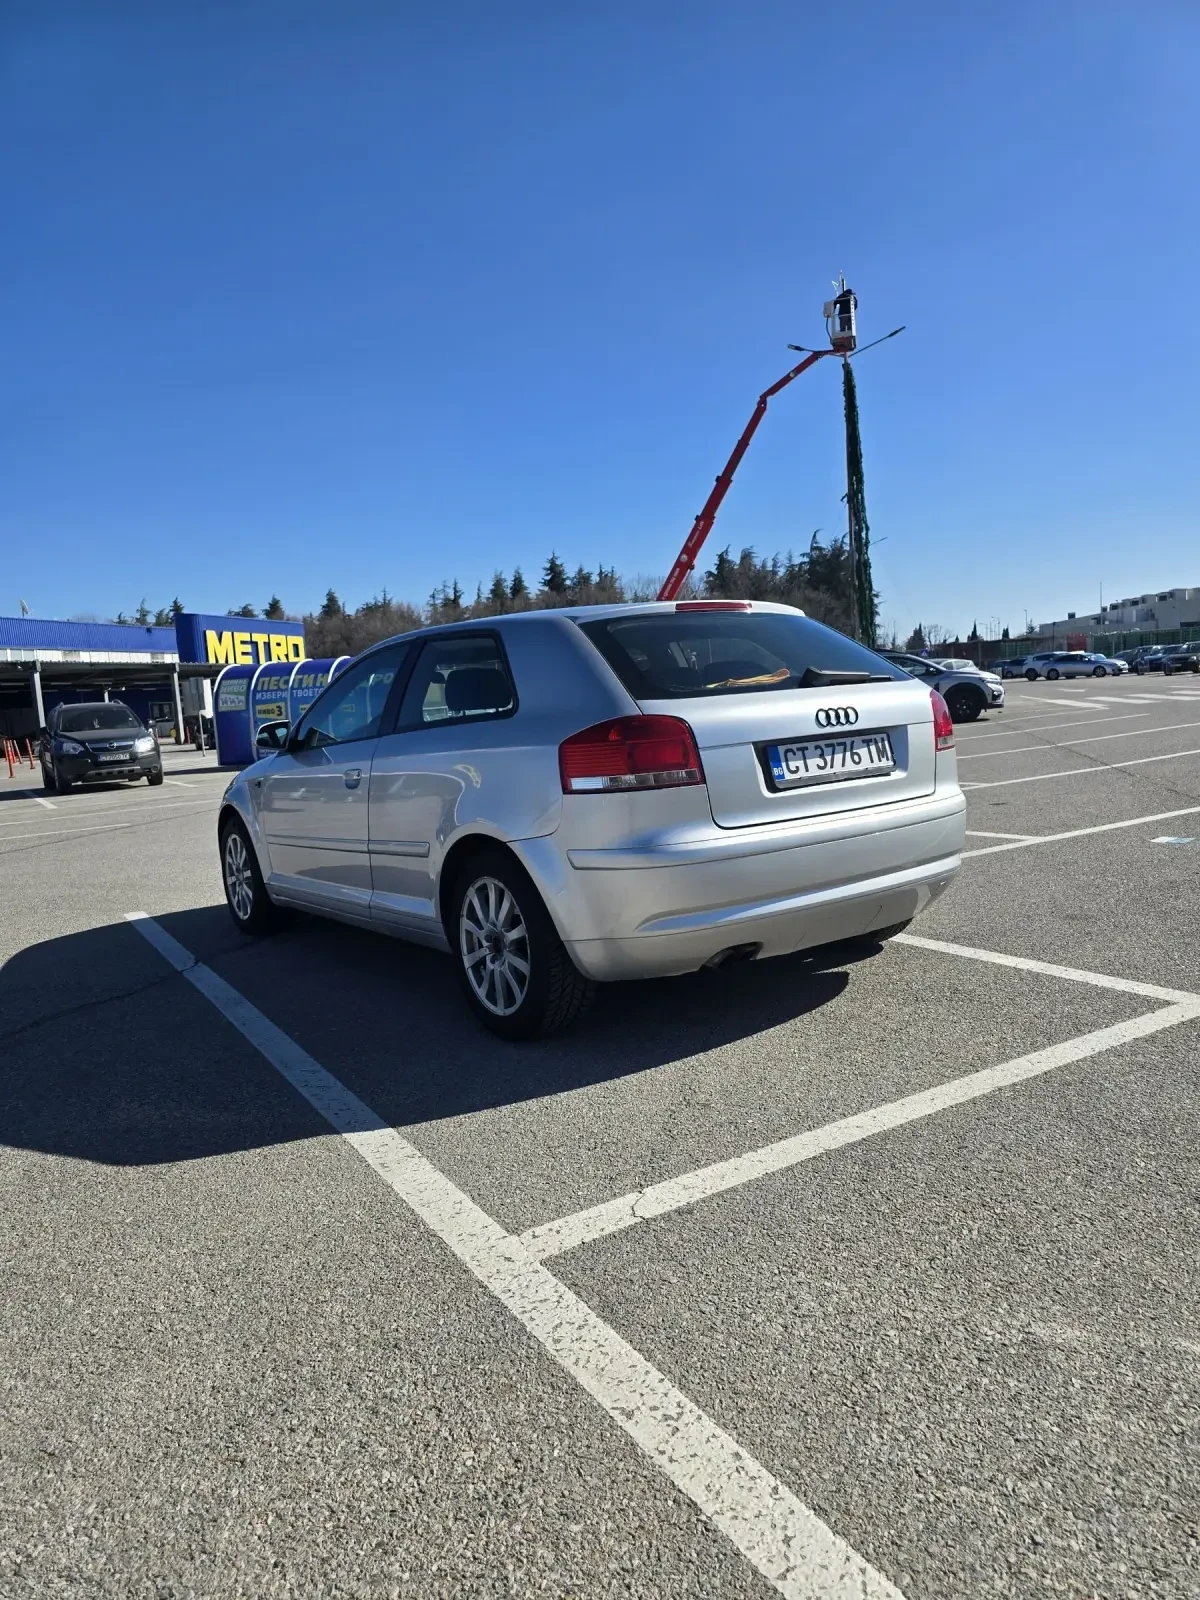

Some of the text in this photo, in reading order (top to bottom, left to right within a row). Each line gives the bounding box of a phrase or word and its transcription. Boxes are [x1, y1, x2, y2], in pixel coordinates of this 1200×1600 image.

[205, 630, 305, 664] METRO
[258, 674, 315, 690] ПЕСТИ
[255, 690, 289, 700] ИЗБЕРИ
[276, 705, 283, 717] 3
[783, 737, 890, 775] CT 3776 TM
[773, 767, 784, 776] BG
